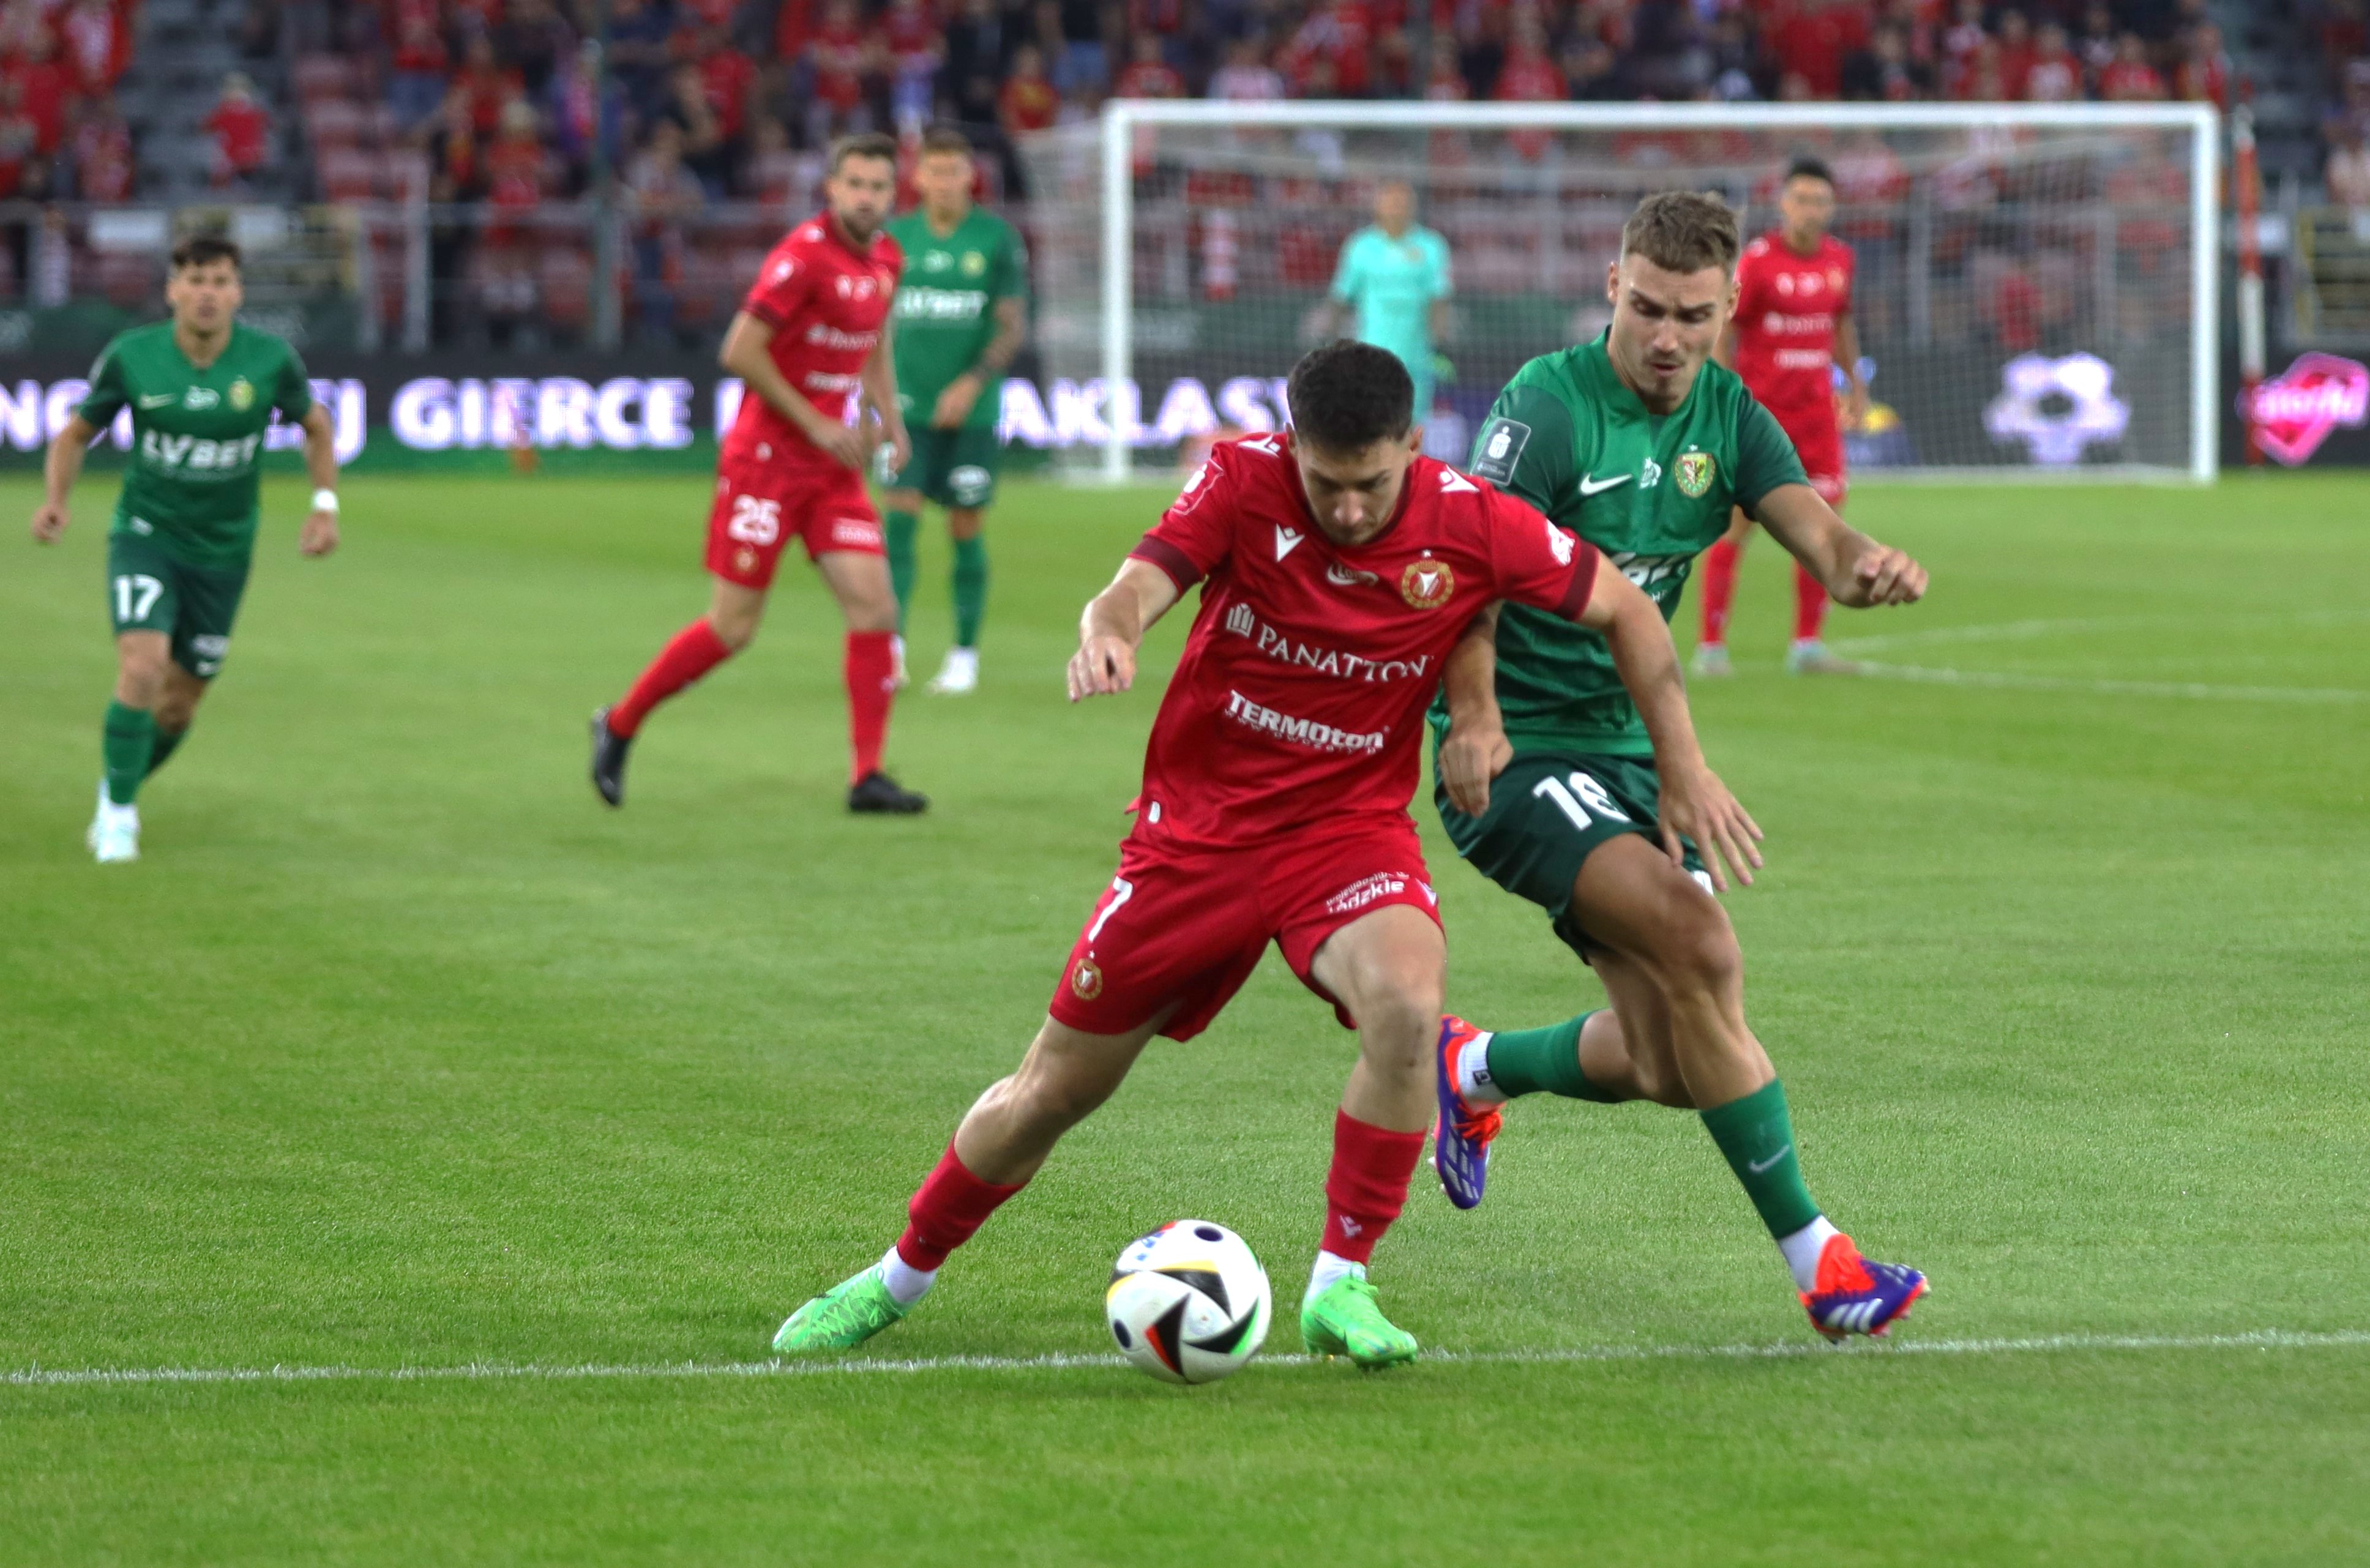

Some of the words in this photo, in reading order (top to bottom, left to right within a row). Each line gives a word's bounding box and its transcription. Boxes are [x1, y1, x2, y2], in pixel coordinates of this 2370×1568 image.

[389, 376, 694, 450] GIERCE
[141, 428, 261, 469] LVBET
[728, 494, 782, 547] 25
[114, 573, 165, 622] 17
[1257, 622, 1429, 682] PANATTON
[1088, 875, 1133, 943] 7
